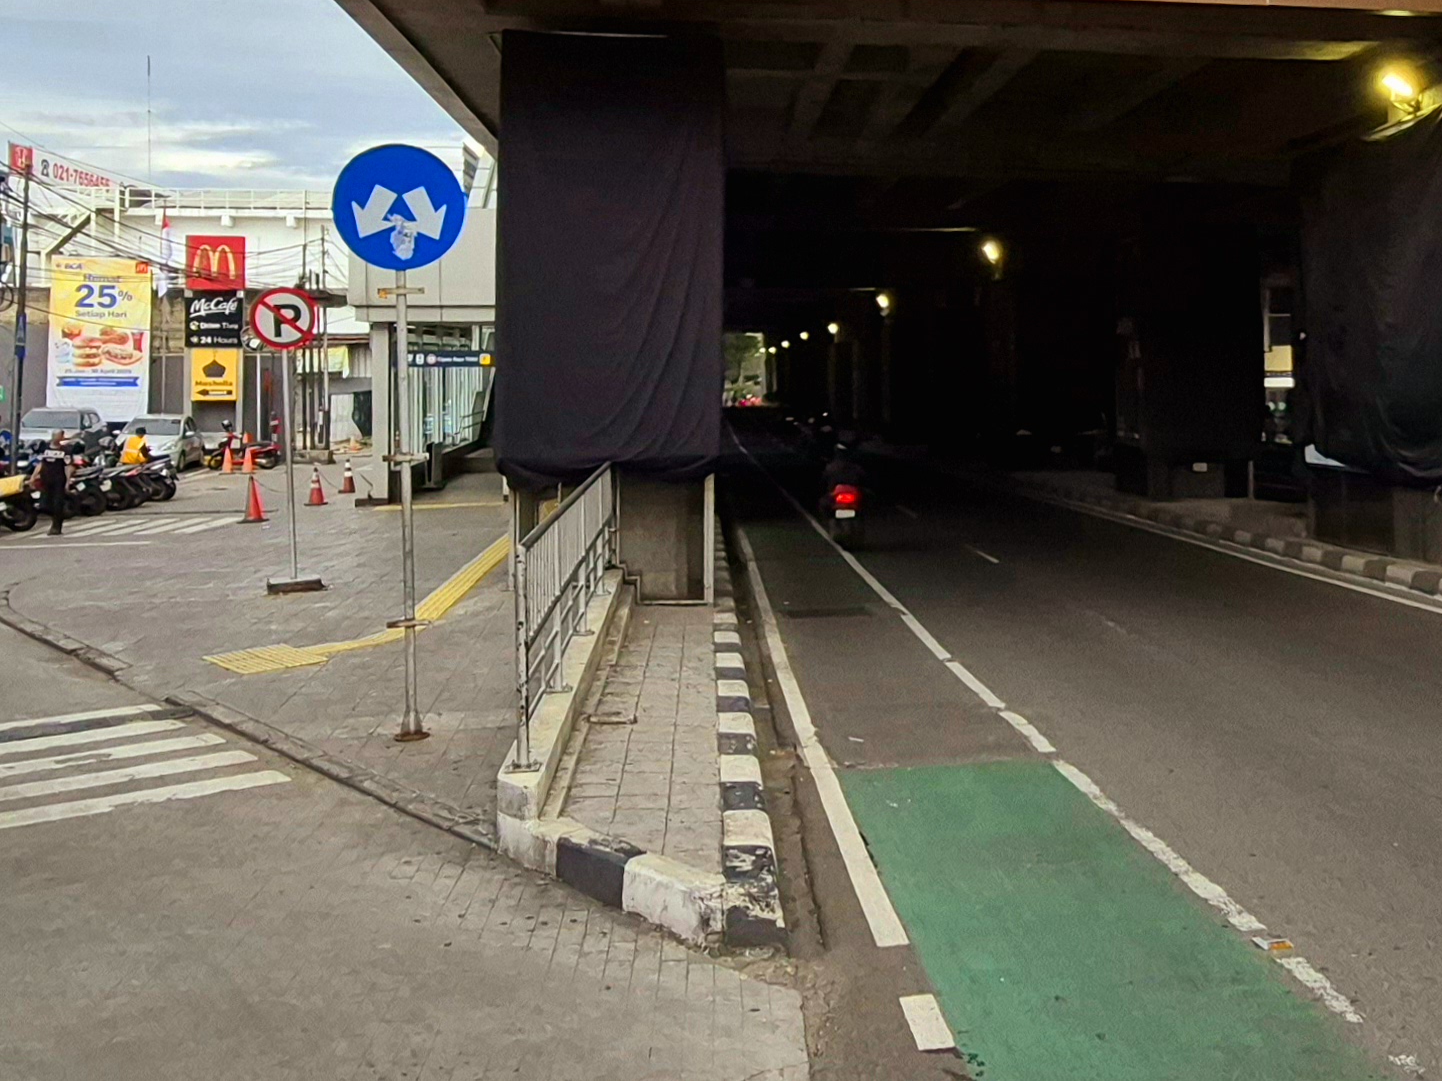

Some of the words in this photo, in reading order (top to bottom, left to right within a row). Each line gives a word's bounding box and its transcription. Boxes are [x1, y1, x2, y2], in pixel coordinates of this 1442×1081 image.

[76, 310, 105, 319] Setiap
[108, 310, 127, 318] Hari
[273, 304, 302, 338] P
[200, 336, 212, 344] 24
[213, 336, 238, 344] Hours
